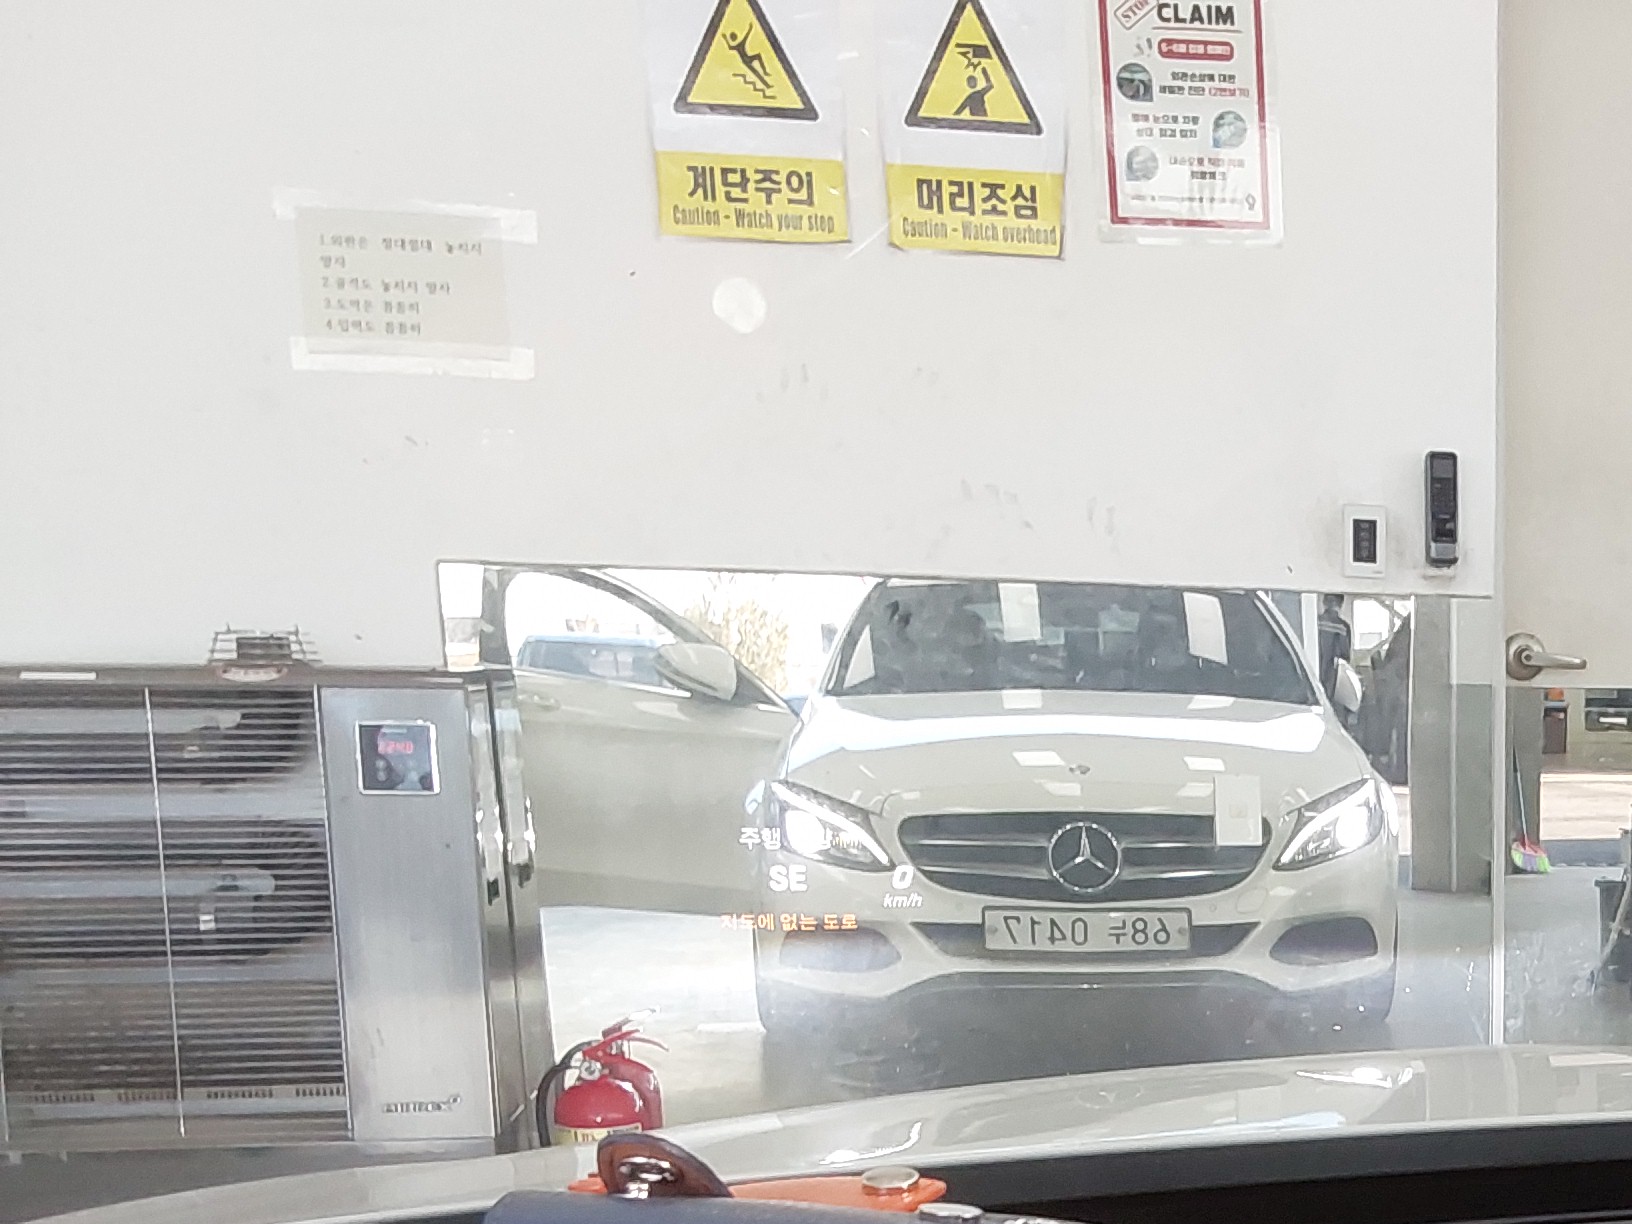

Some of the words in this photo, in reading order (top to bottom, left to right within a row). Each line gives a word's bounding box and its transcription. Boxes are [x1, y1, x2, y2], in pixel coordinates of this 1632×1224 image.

[1157, 3, 1235, 26] CLAIM
[687, 165, 815, 207] 계단주의
[916, 177, 1039, 220] 머리조심
[673, 204, 721, 226] Caution
[734, 207, 773, 231] Watch
[778, 213, 803, 232] your
[807, 213, 835, 234] step
[902, 216, 947, 239] Caution
[962, 220, 999, 242] Watch
[1003, 224, 1057, 246] overhead
[739, 827, 782, 850] 주행
[768, 864, 808, 892] SE
[892, 864, 914, 889] 0
[883, 893, 923, 908] km/h
[720, 913, 775, 931] 지도에
[779, 913, 818, 931] 없는
[823, 913, 858, 931] 도로
